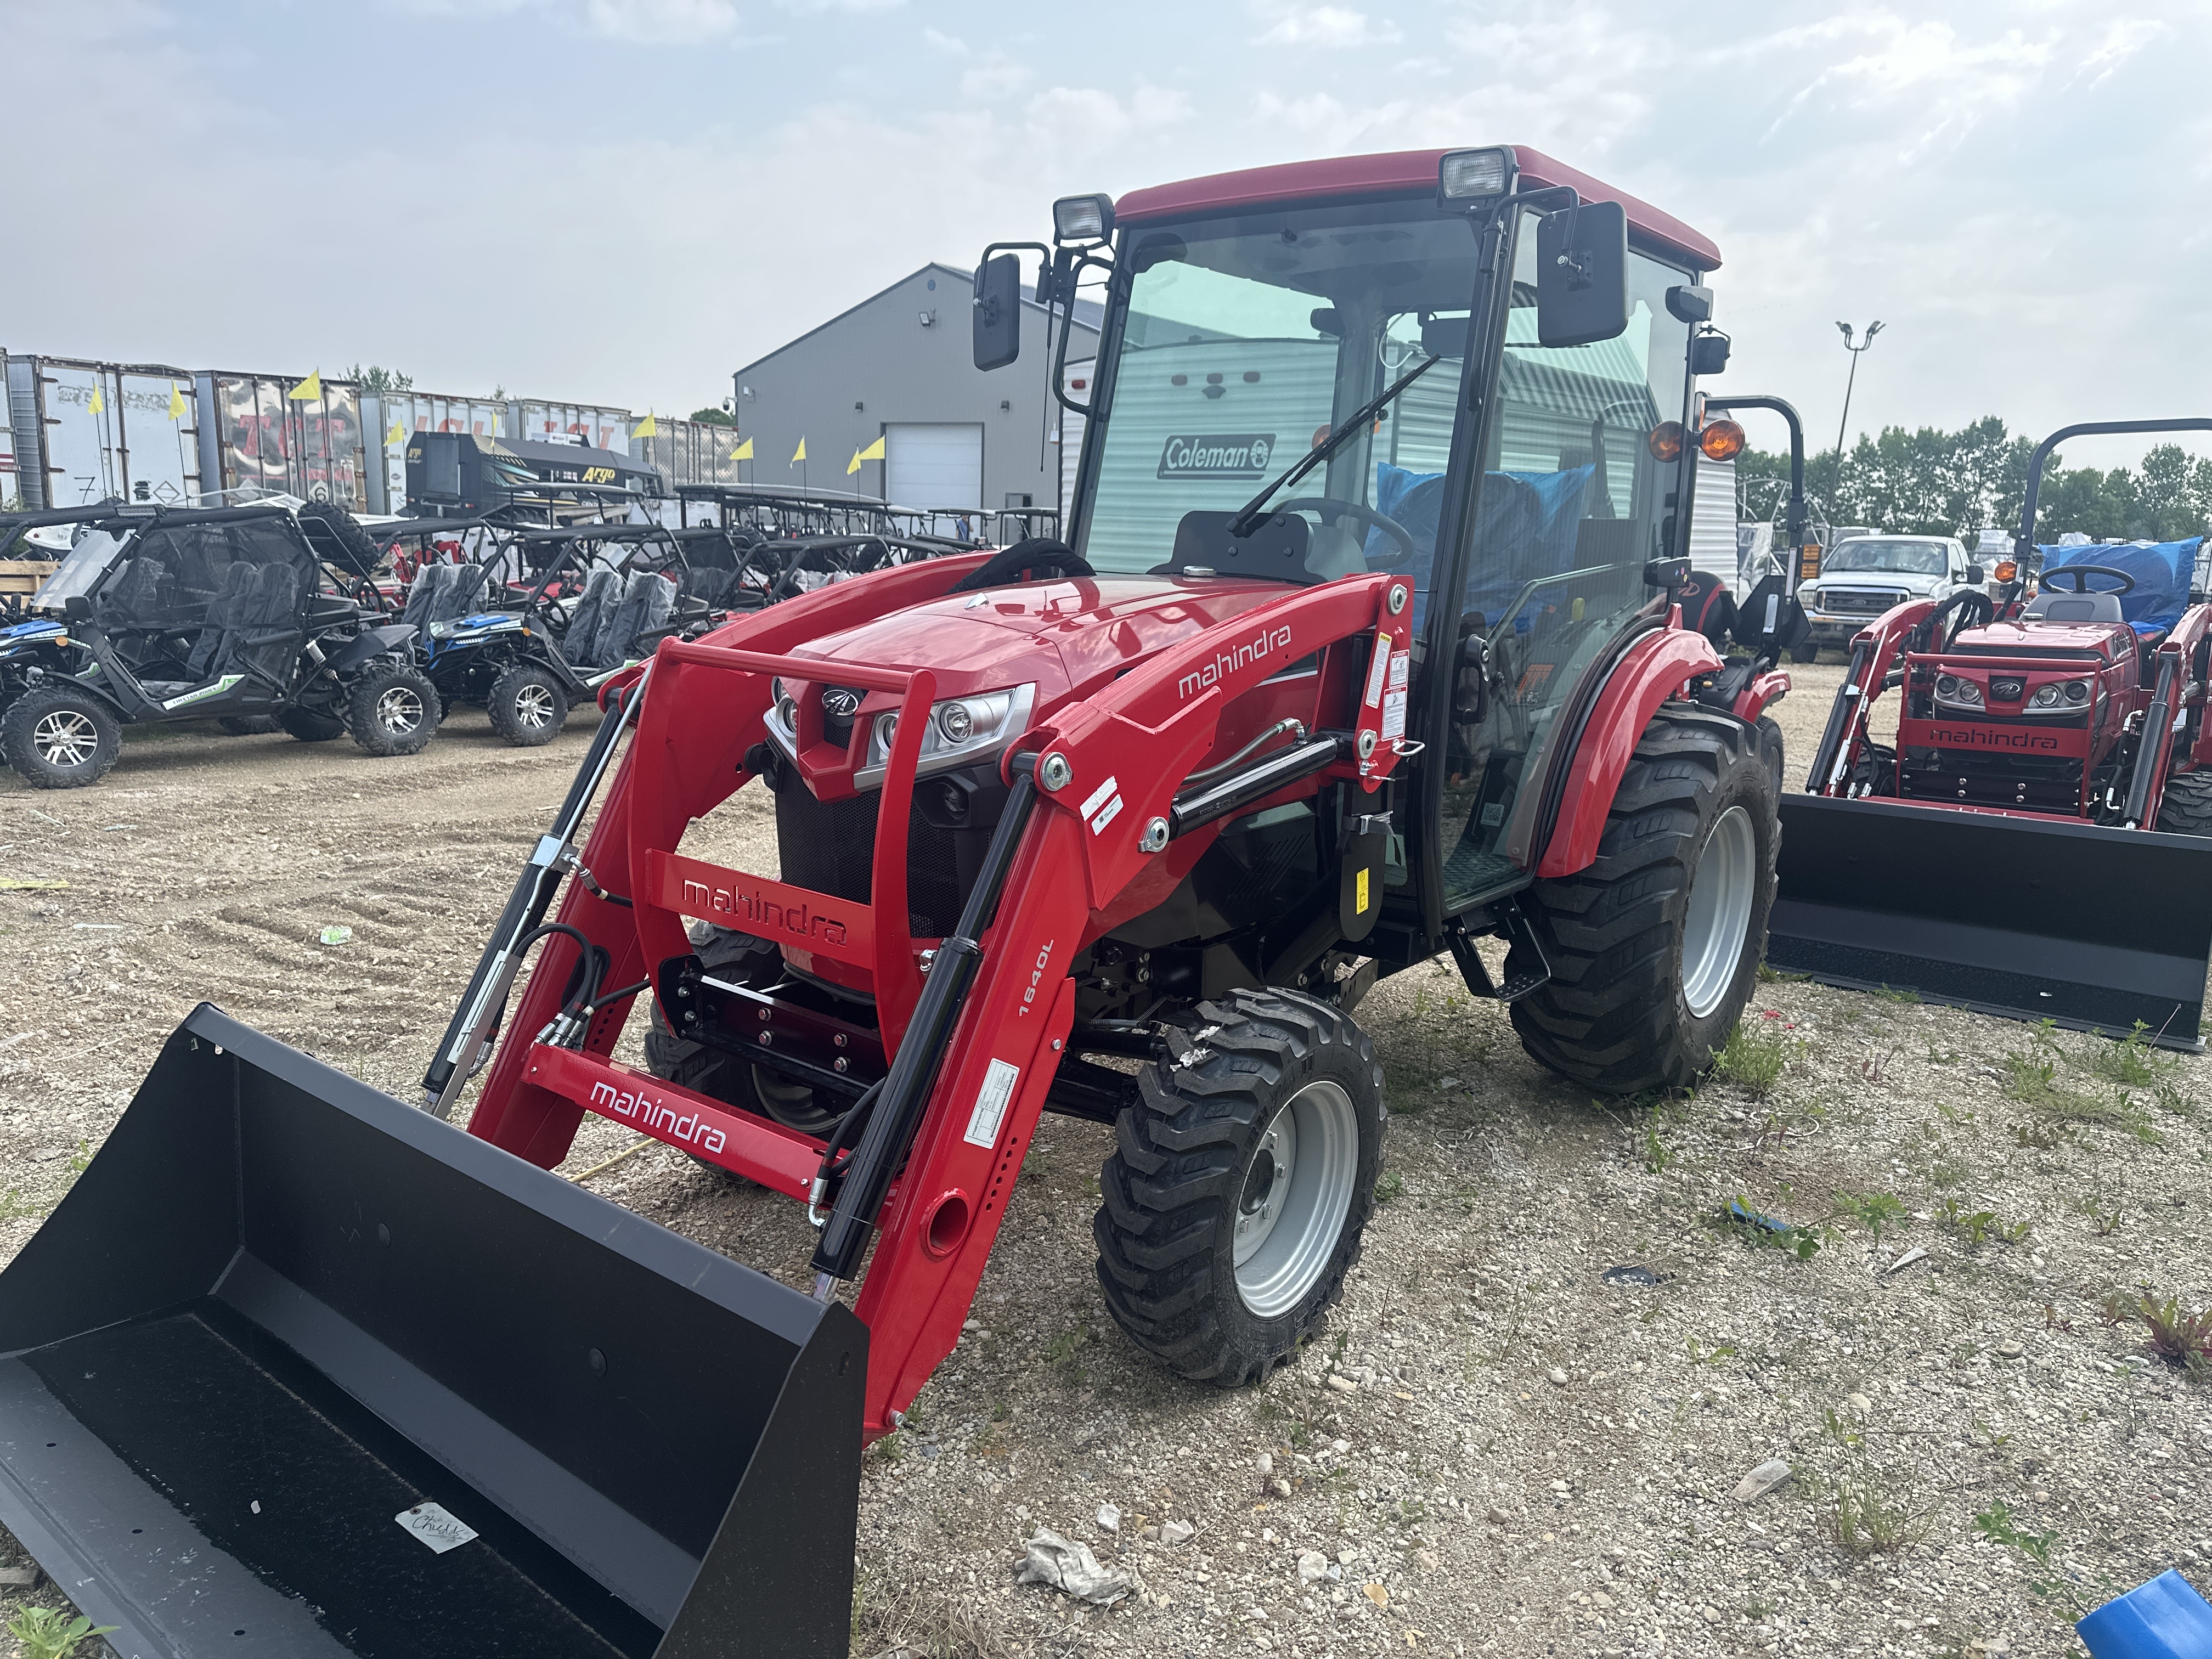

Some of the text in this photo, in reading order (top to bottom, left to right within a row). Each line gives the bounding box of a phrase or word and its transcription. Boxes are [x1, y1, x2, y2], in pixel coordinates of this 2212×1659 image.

[582, 466, 616, 484] Argo
[1166, 438, 1248, 469] Coleman
[1179, 625, 1291, 699] mahindra
[1930, 729, 2058, 749] mahindra
[682, 879, 847, 947] mahindra
[1019, 939, 1054, 1017] 1640L
[590, 1081, 726, 1154] mahindra
